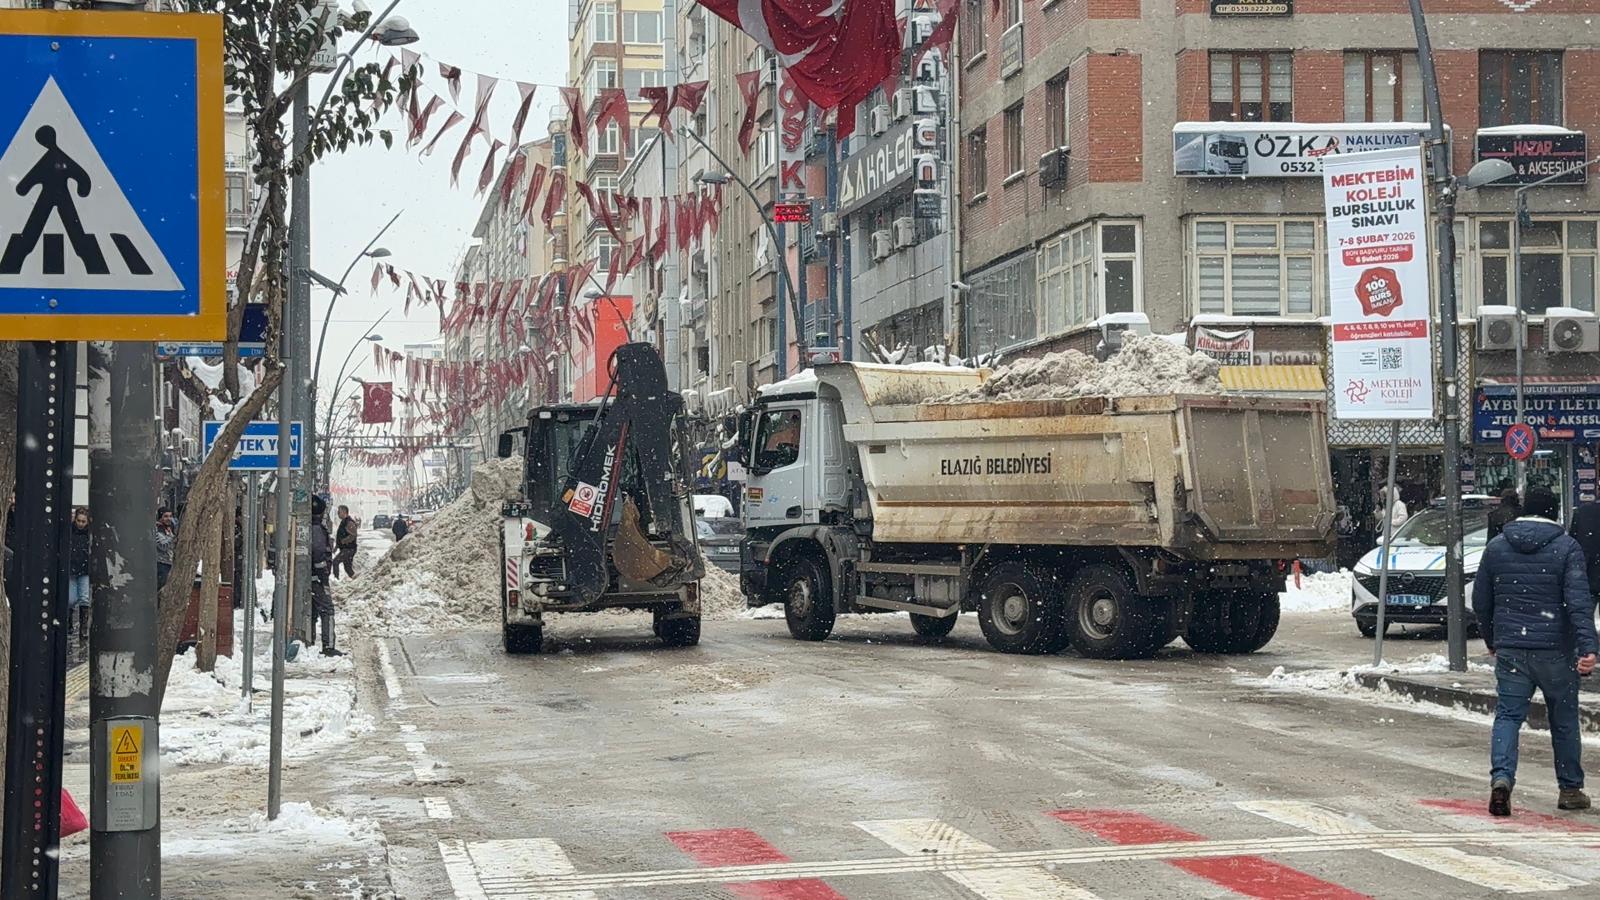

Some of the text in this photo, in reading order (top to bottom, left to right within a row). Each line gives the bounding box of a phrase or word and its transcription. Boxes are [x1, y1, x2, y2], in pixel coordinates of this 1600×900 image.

[1254, 134, 1341, 158] ÖZKA
[1346, 132, 1409, 146] NAKLİYAT
[1514, 140, 1552, 156] HAZAR
[1281, 162, 1315, 173] 0532
[1518, 164, 1525, 175] &
[1331, 165, 1415, 187] MEKTEBİM
[1346, 182, 1402, 202] KOLEJİ
[1332, 199, 1416, 217] BURSLULUK
[1352, 214, 1399, 228] SINAVI
[1338, 232, 1415, 246] 7-8 ŞUBAT 2026
[1365, 278, 1386, 292] 100
[1369, 290, 1392, 303] BURS
[1371, 377, 1422, 388] MEKTEBİM
[1381, 389, 1413, 399] KOLEJİ
[240, 439, 296, 451] TEK YN
[941, 452, 1051, 475] ELAZIĞ BELEDİYESİ
[590, 444, 616, 532] HİDROMEK
